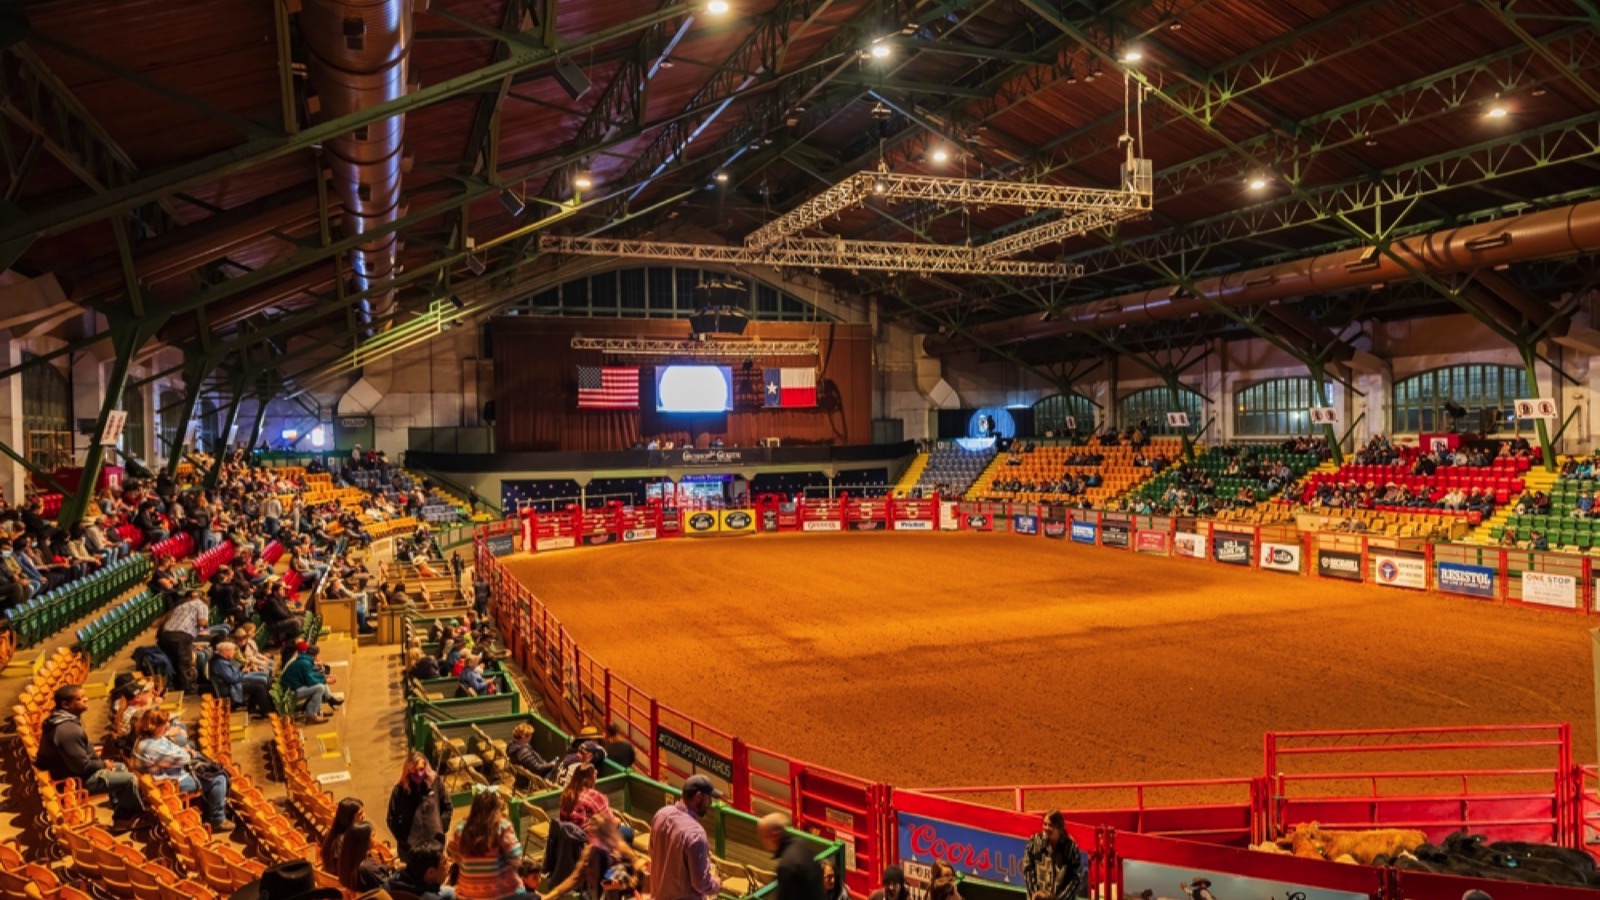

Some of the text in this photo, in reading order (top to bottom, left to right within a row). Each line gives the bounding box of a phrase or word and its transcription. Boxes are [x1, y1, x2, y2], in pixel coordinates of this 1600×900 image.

[1440, 568, 1491, 584] RESISTOL
[1526, 574, 1571, 584] ONE STOP
[908, 823, 992, 871] Coors
